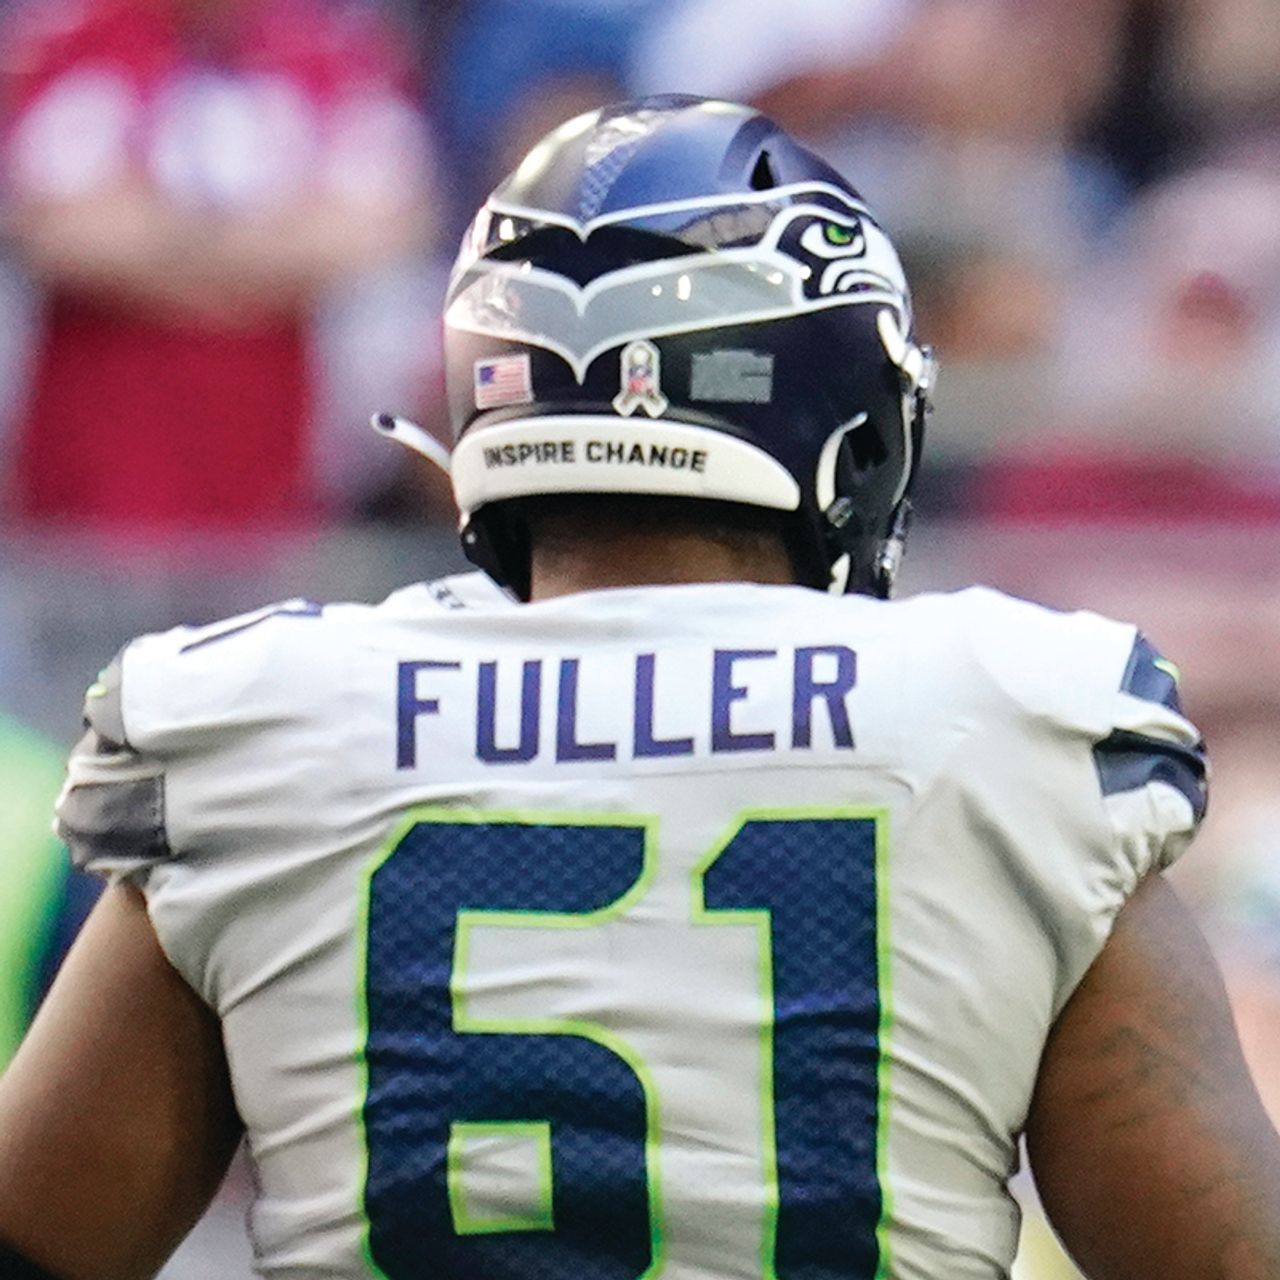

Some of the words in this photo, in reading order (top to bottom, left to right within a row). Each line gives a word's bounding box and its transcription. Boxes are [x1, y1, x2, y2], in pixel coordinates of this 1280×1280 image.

[484, 440, 576, 470] INSPIRE
[585, 440, 708, 474] CHANGE
[395, 644, 858, 770] FULLER
